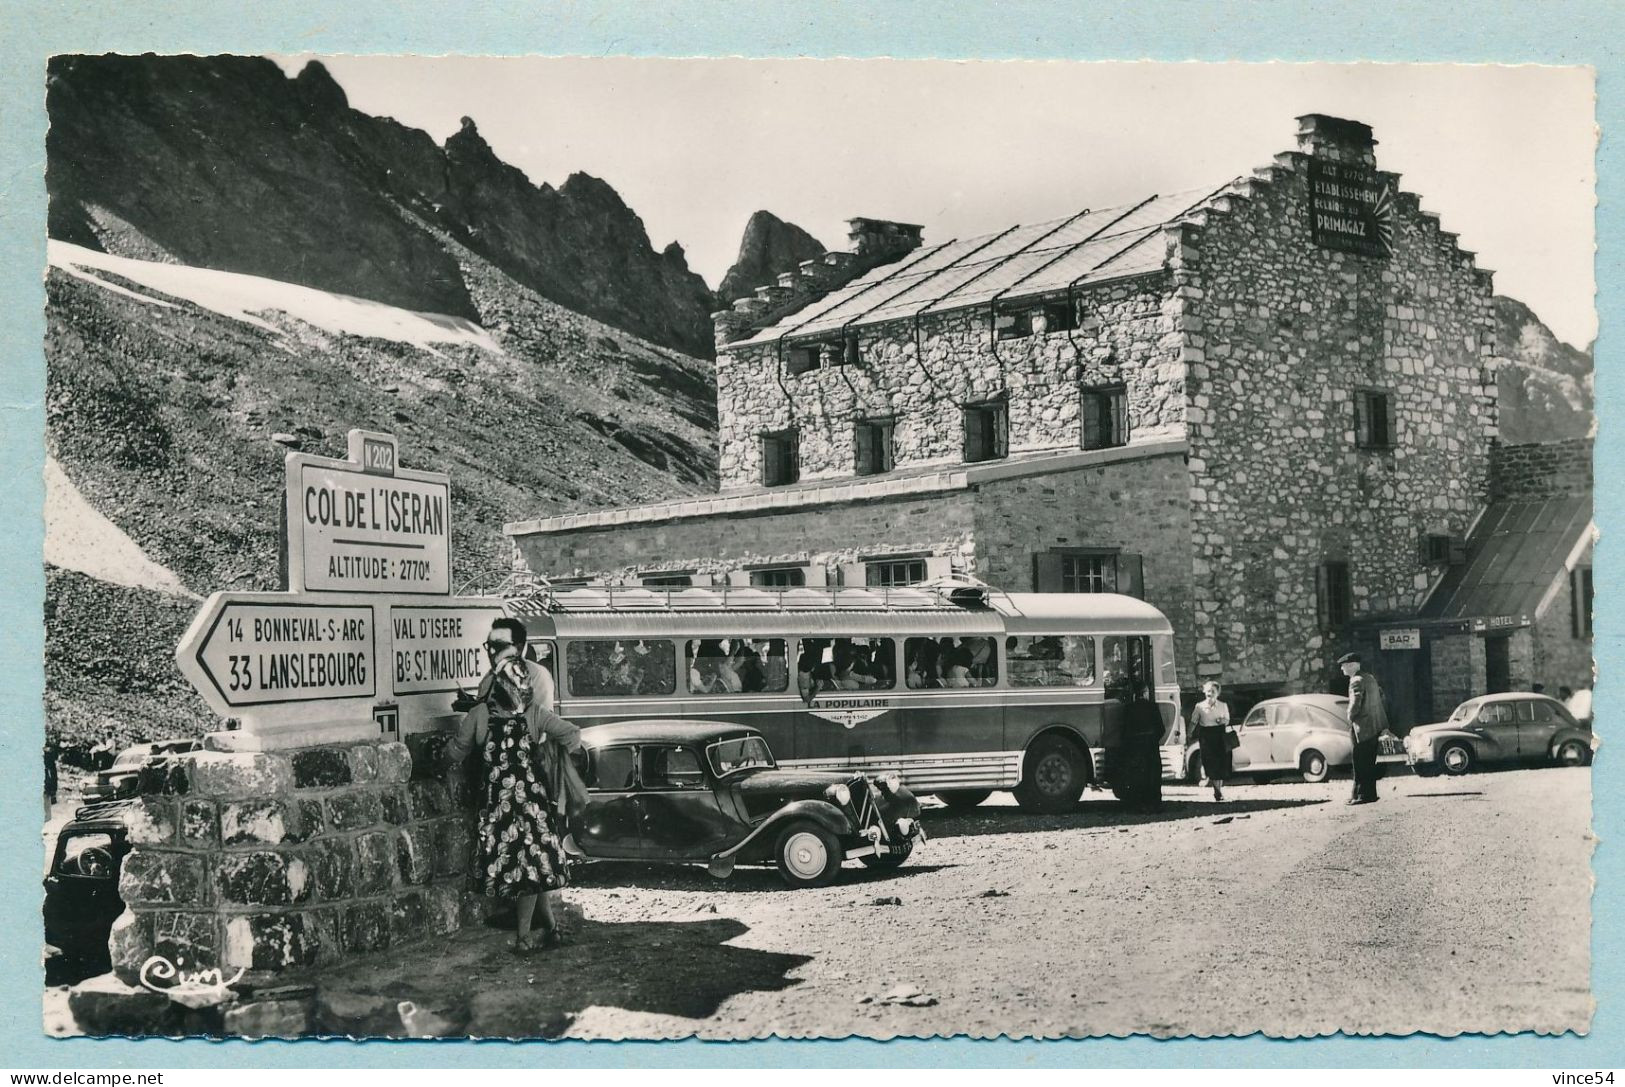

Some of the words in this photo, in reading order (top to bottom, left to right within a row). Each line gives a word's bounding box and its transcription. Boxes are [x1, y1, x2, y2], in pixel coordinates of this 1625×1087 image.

[1315, 181, 1379, 204] ETABLISSEMENT
[1317, 214, 1366, 237] PRIMAGAZ
[374, 446, 393, 469] 202
[305, 485, 341, 526] COL
[345, 491, 366, 528] DE
[371, 488, 443, 535] L'ISERAN
[328, 555, 388, 580] ALTITUDE
[227, 618, 243, 642] 14
[393, 619, 415, 640] VAL
[419, 618, 463, 638] D'ISERE
[1490, 616, 1514, 626] HOTEL
[1388, 635, 1410, 644] BAR
[228, 655, 252, 691] 33
[259, 652, 367, 690] LANSLEBOURG
[430, 649, 482, 679] MAURICE
[808, 700, 820, 709] LA
[826, 699, 889, 709] POPULAIRE
